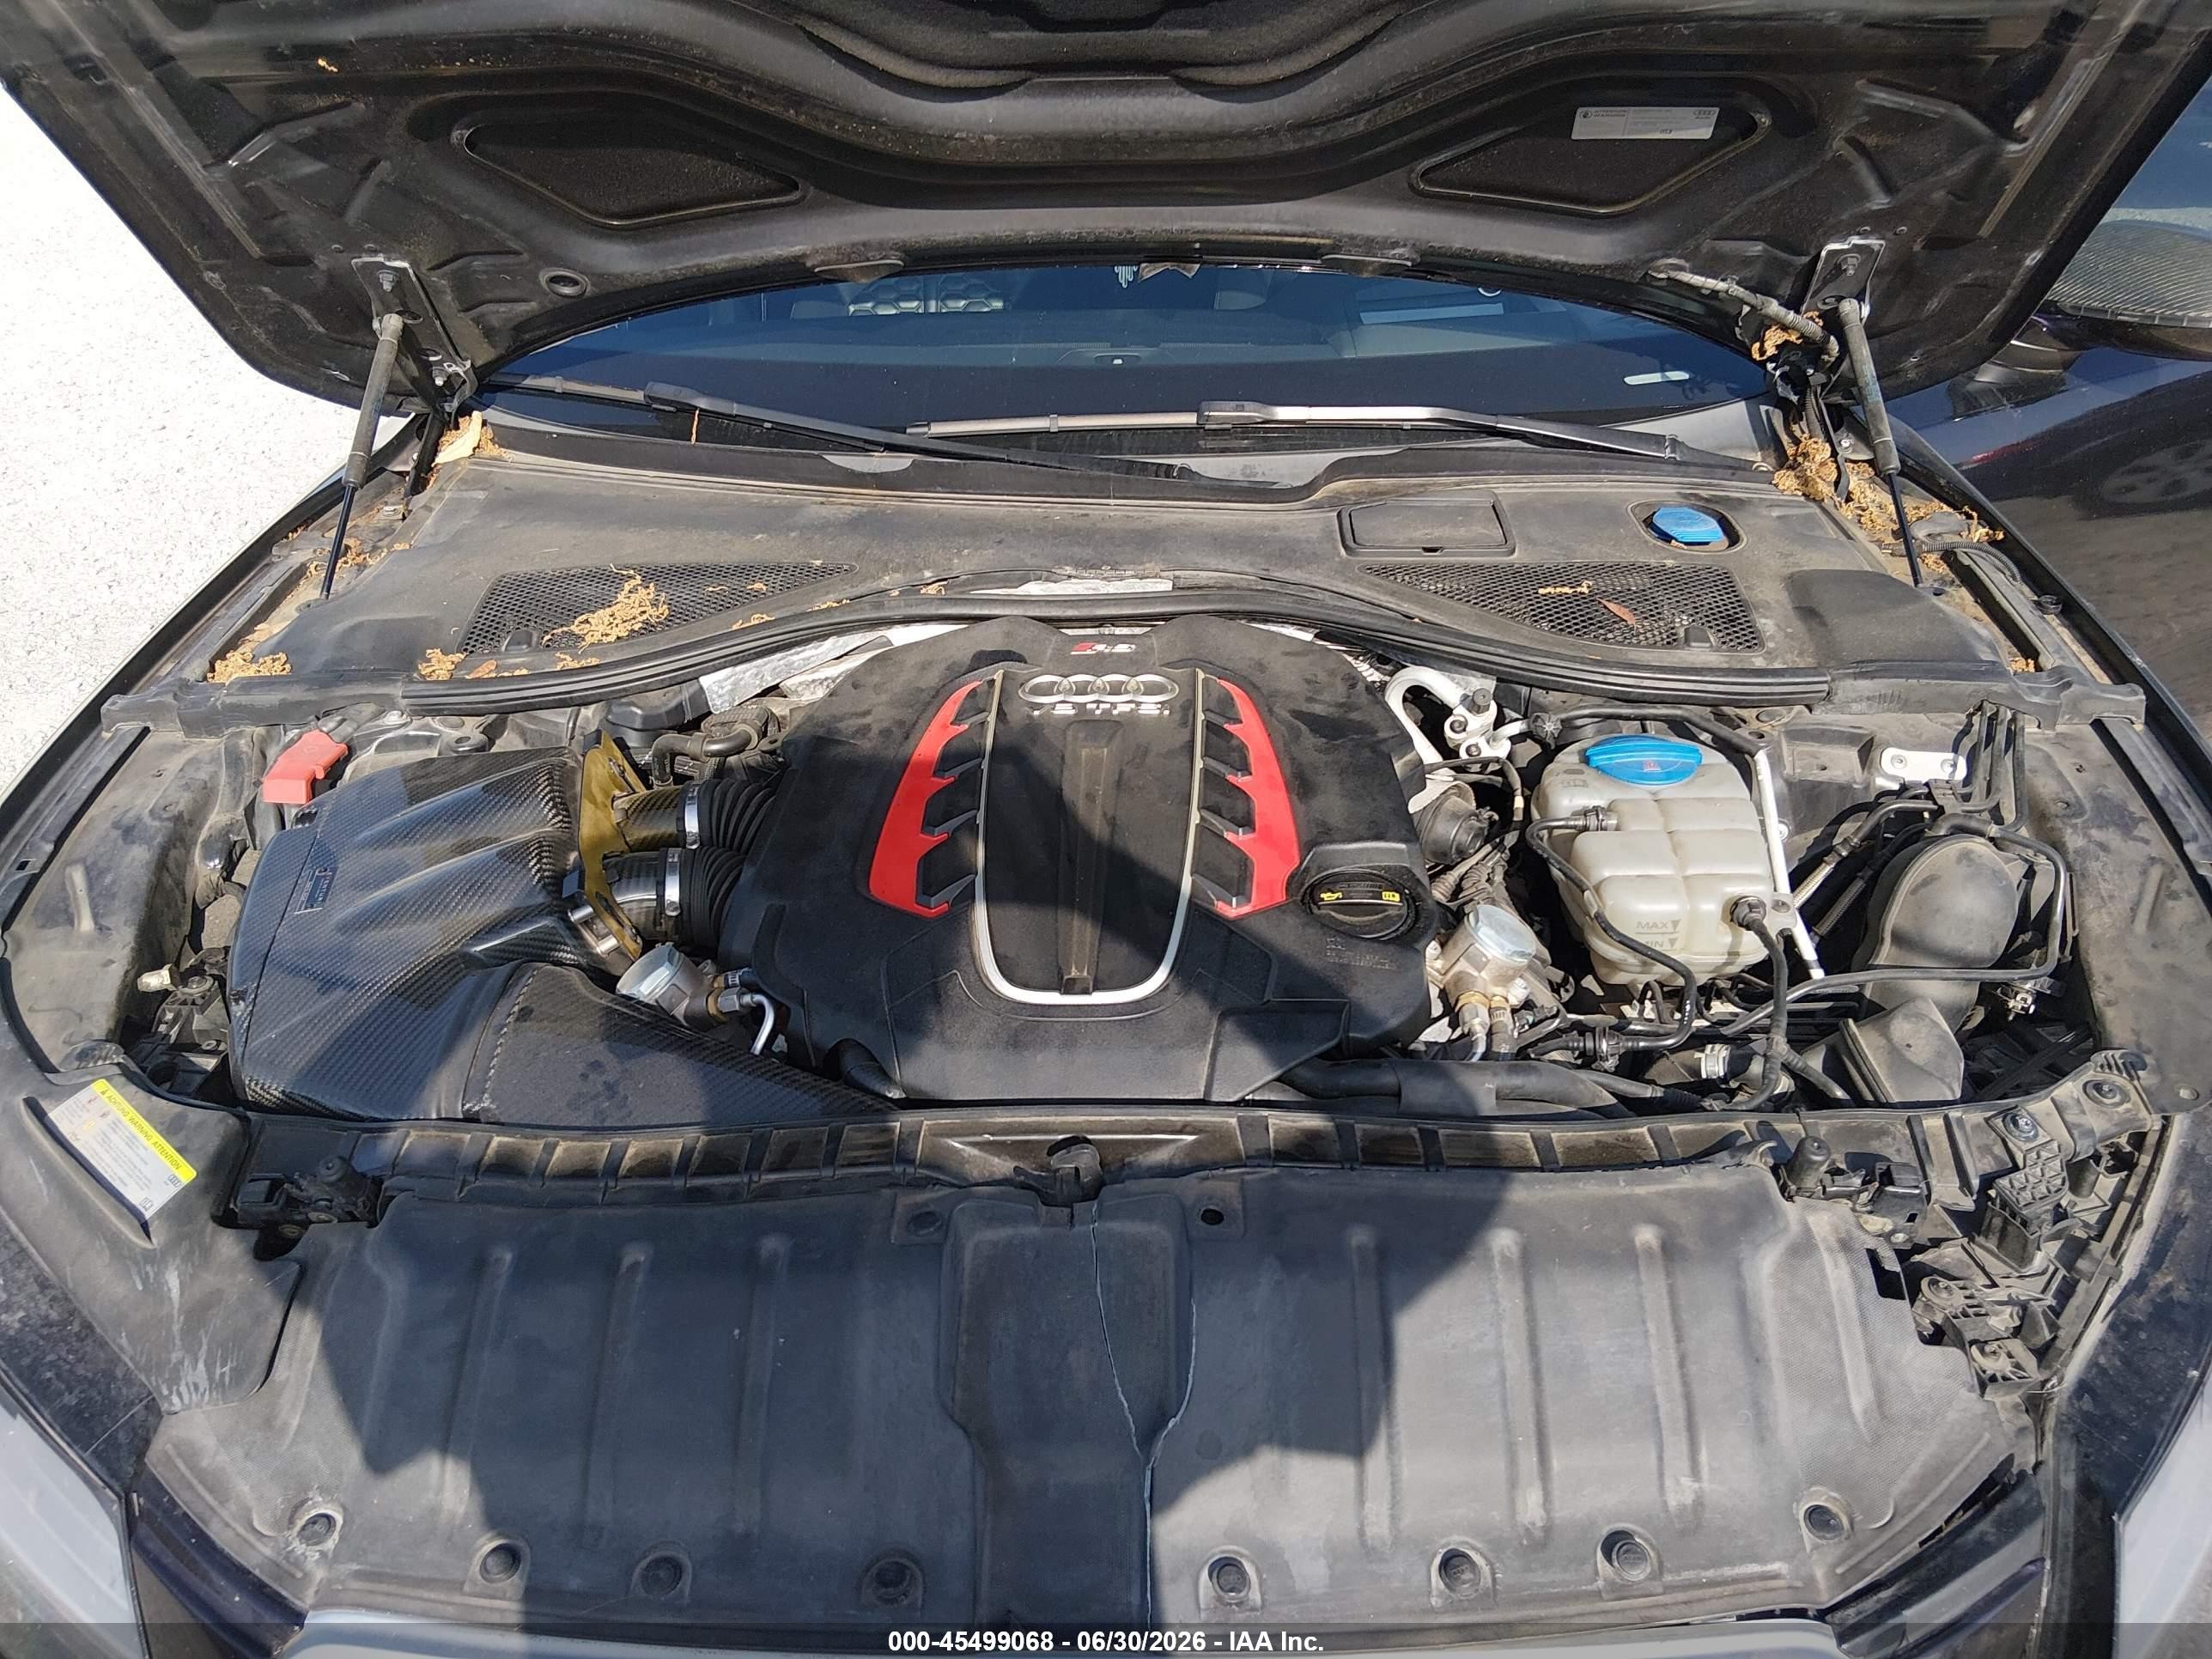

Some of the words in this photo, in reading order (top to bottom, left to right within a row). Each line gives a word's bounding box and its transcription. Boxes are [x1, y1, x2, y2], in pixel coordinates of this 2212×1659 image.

[1636, 921, 1669, 930] MAX
[128, 1115, 153, 1141] WARNING
[152, 1140, 183, 1170] ATTENTION
